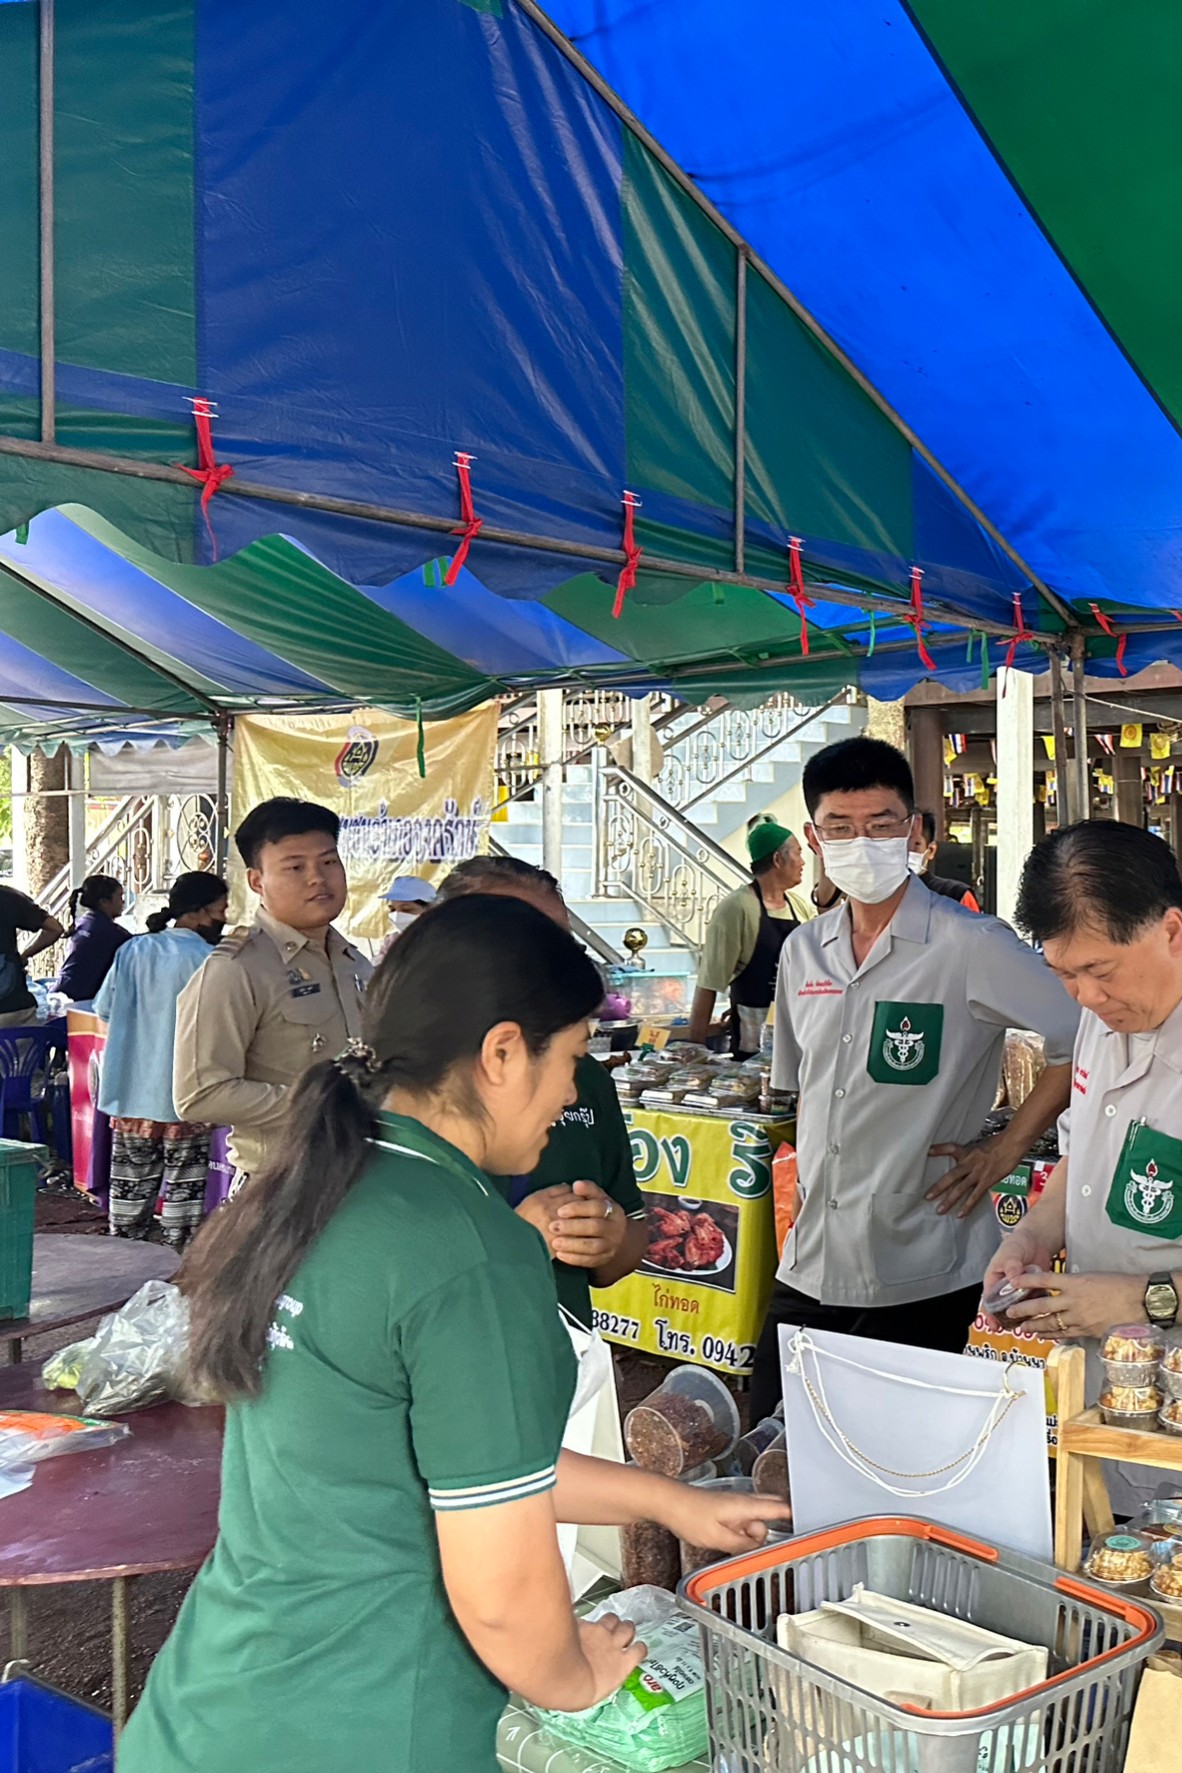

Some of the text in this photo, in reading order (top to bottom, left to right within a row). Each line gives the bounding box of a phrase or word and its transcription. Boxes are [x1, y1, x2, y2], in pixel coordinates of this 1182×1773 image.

[652, 1283, 700, 1314] ไก่ทอด
[655, 1319, 695, 1356] โทร.
[702, 1335, 756, 1369] 0942
[643, 1674, 664, 1692] aro
